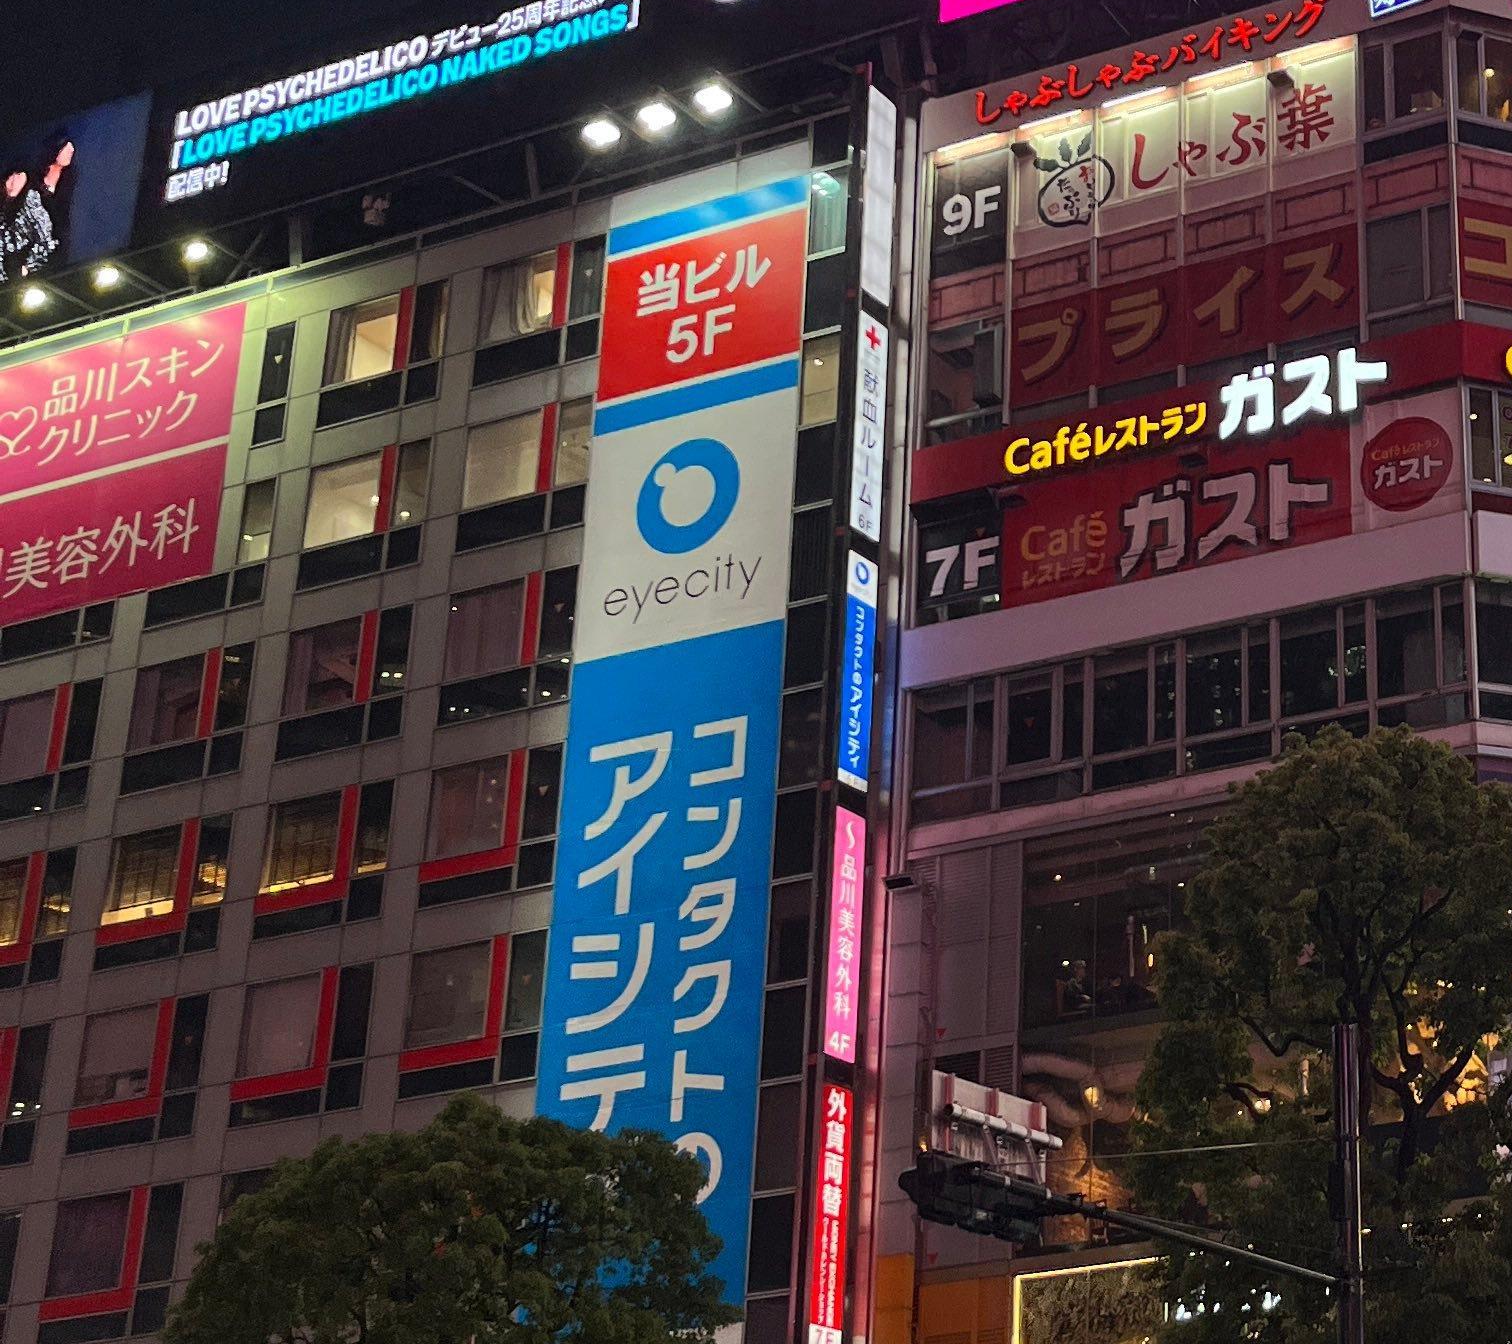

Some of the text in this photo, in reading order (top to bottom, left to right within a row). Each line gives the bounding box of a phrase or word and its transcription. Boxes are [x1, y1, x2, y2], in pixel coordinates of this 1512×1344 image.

[175, 92, 241, 137] LOVE
[243, 35, 429, 116] PSYCHEDELICO
[249, 66, 438, 146] PSYCHEDELICO
[438, 34, 532, 86] NAKED
[1130, 83, 1335, 191] しゃぶ葉
[942, 184, 1001, 237] 9F
[636, 243, 772, 317] 当ビル
[1017, 242, 1354, 383] プライス
[665, 304, 736, 364] 5F
[42, 339, 225, 418] 品川スキン
[1219, 347, 1389, 440] ガスト
[36, 390, 199, 467] クリニック
[1374, 454, 1443, 490] ガスト
[0, 497, 199, 598] 美容外科
[856, 514, 874, 532] 6F
[1020, 510, 1108, 562] Café
[1120, 463, 1329, 579] ガスト
[603, 554, 762, 624] eyecity
[926, 536, 1000, 597] 7F
[1022, 555, 1102, 588] レストラン
[670, 715, 749, 1205] コンタクトの
[833, 853, 859, 1019] 品川美容外科
[829, 1030, 851, 1053] 4F
[822, 1087, 848, 1217] 外貨両替
